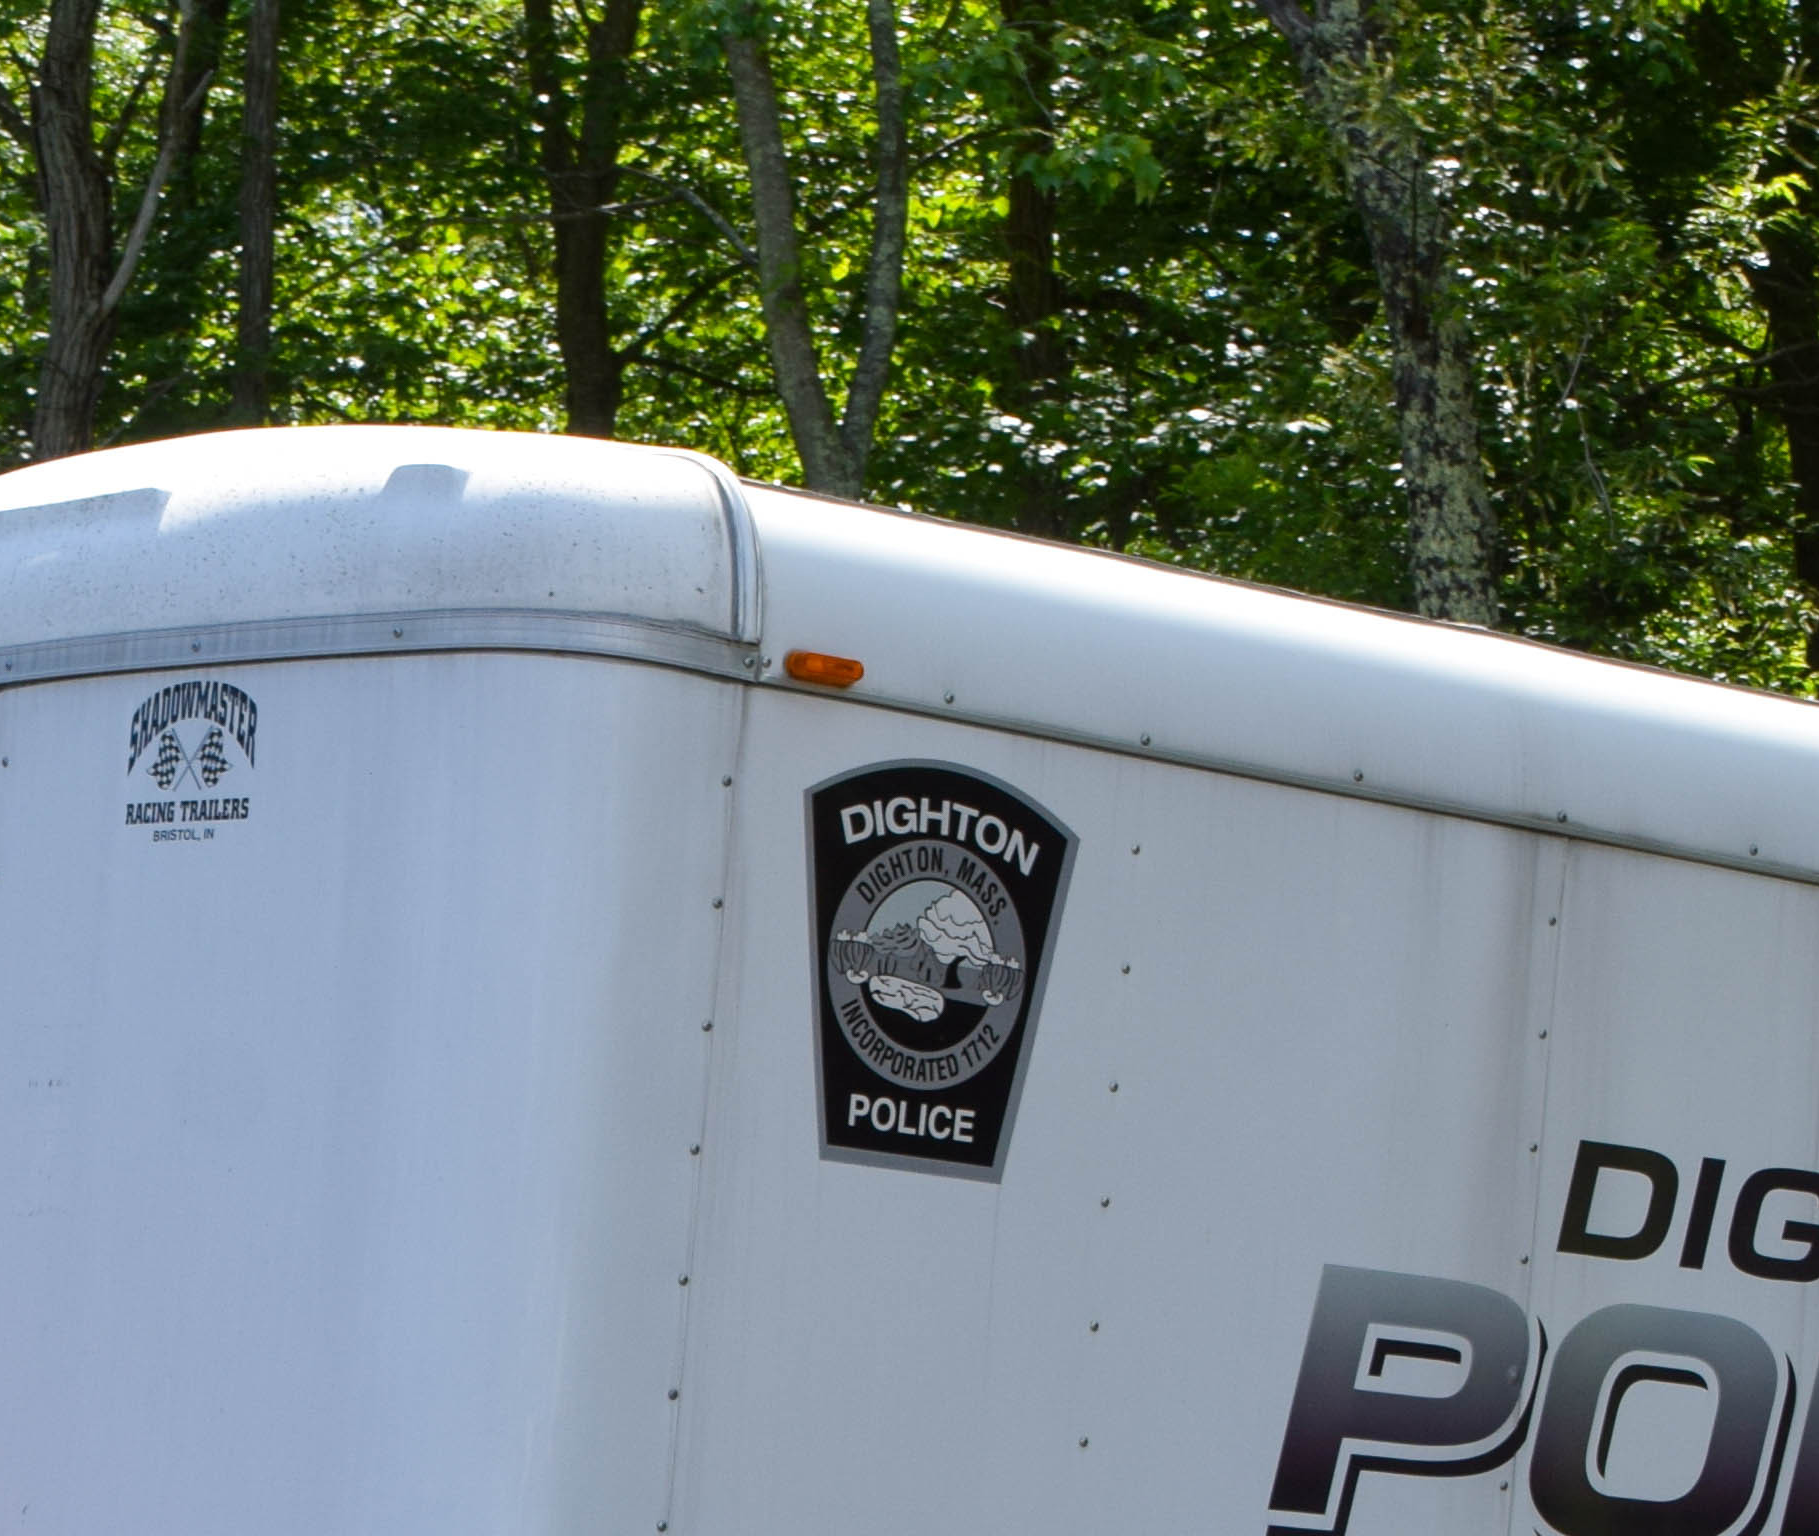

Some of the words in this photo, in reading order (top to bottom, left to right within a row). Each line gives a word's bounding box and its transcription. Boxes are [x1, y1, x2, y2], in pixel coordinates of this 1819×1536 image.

[128, 681, 258, 776] SHADOWMASTER
[125, 801, 175, 825] RACING
[180, 797, 250, 821] TRAILERS
[153, 828, 201, 842] BRISTOL,
[204, 828, 215, 840] IN
[840, 796, 1039, 877] DIGHTON
[856, 846, 949, 904] DIGHTON,
[956, 857, 1007, 926] MASS.
[840, 999, 959, 1082] INCORPORATED
[961, 1024, 1000, 1068] 1712
[848, 1093, 976, 1143] POLICE
